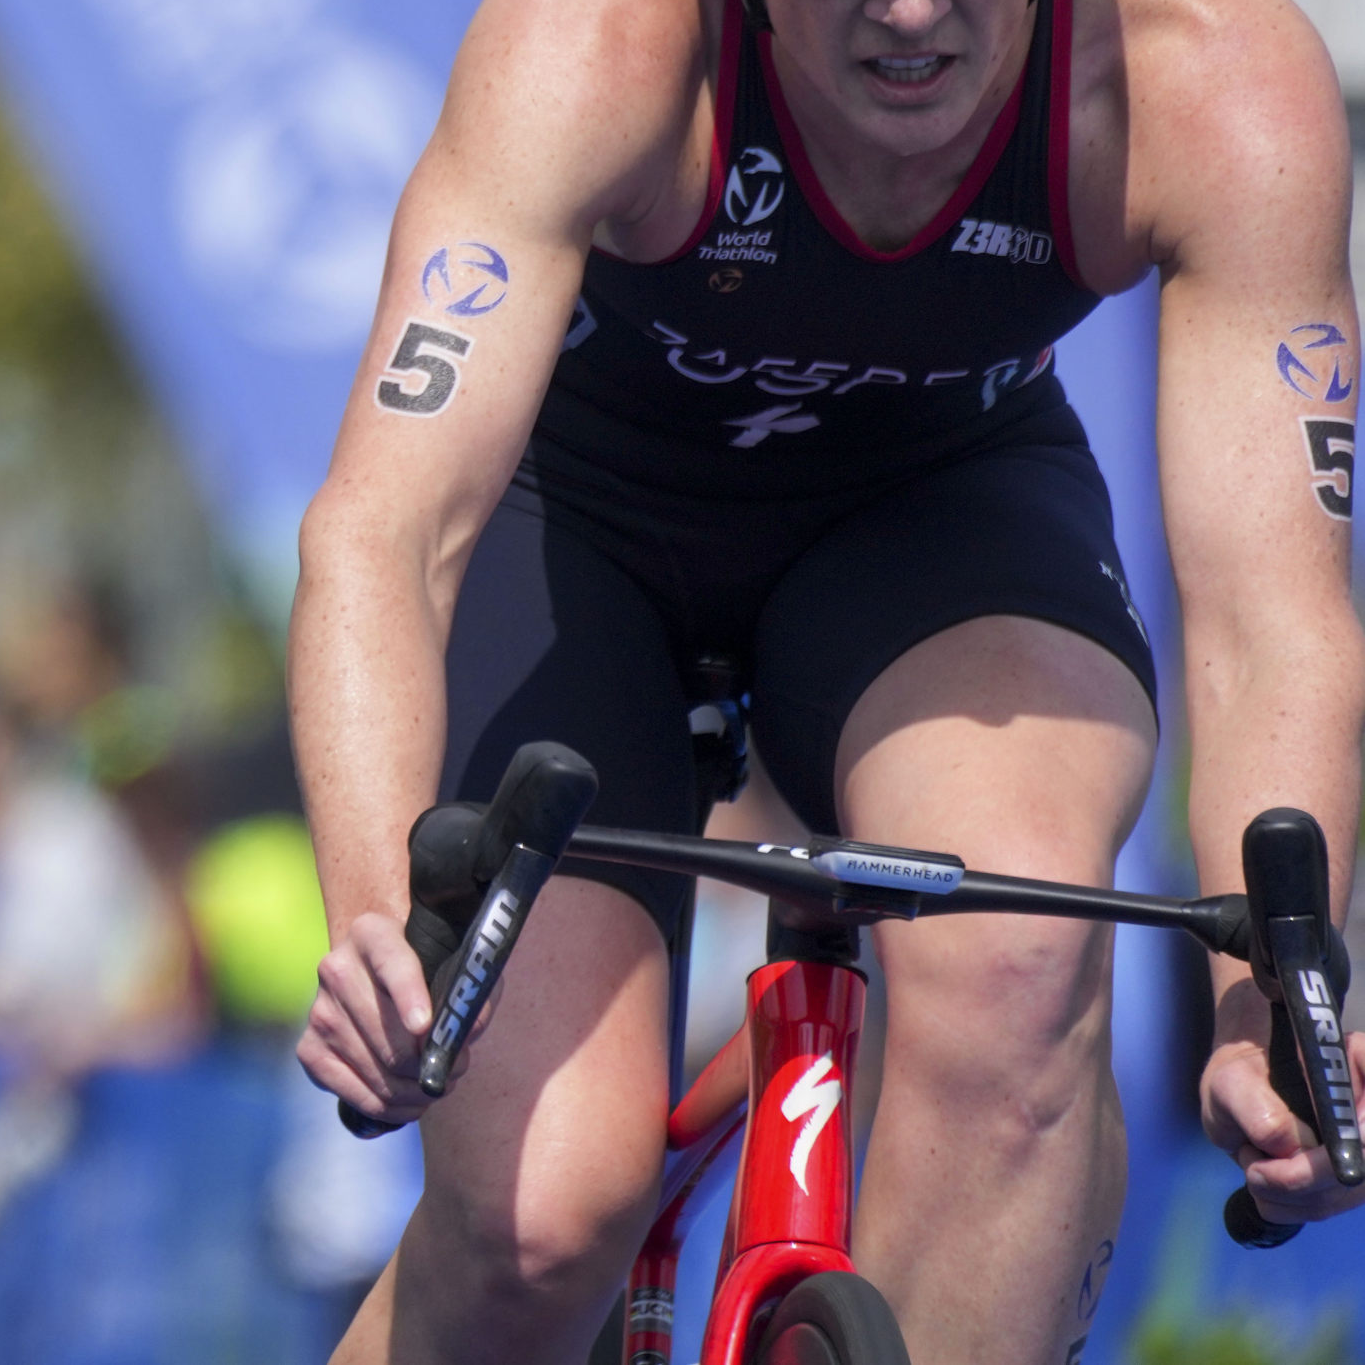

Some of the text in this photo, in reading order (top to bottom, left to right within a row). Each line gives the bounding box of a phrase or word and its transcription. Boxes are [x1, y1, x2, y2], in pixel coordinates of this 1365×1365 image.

[698, 246, 779, 265] Triathlon
[717, 230, 774, 246] World
[374, 316, 476, 419] 5
[1298, 415, 1356, 523] 5
[847, 859, 954, 883] HAMMERHEAD
[432, 889, 520, 1051] SRAM
[1297, 969, 1362, 1140] SRAM
